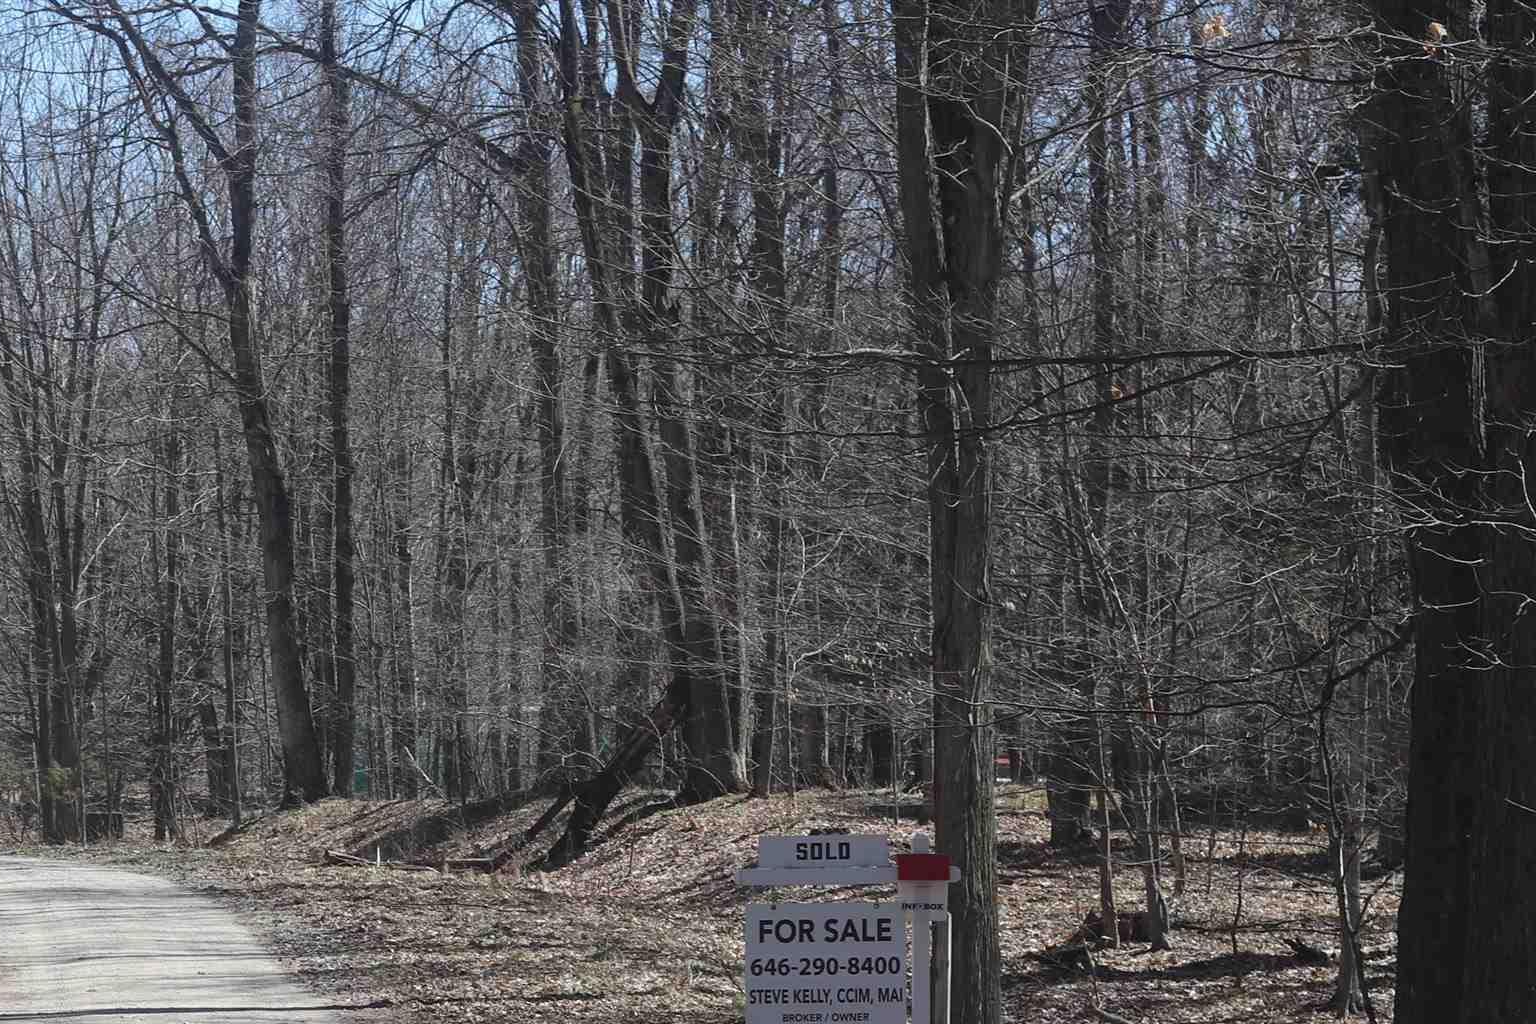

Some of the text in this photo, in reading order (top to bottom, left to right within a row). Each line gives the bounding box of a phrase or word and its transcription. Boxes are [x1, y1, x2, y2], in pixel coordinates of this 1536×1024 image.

[796, 842, 851, 860] SOLD
[759, 918, 893, 943] FOR SALE
[750, 956, 901, 976] 646-290-8400
[750, 987, 903, 1005] STEVE KELLY, CCIM, MAI
[782, 1013, 822, 1023] BROKER
[831, 1012, 869, 1022] OWNER
